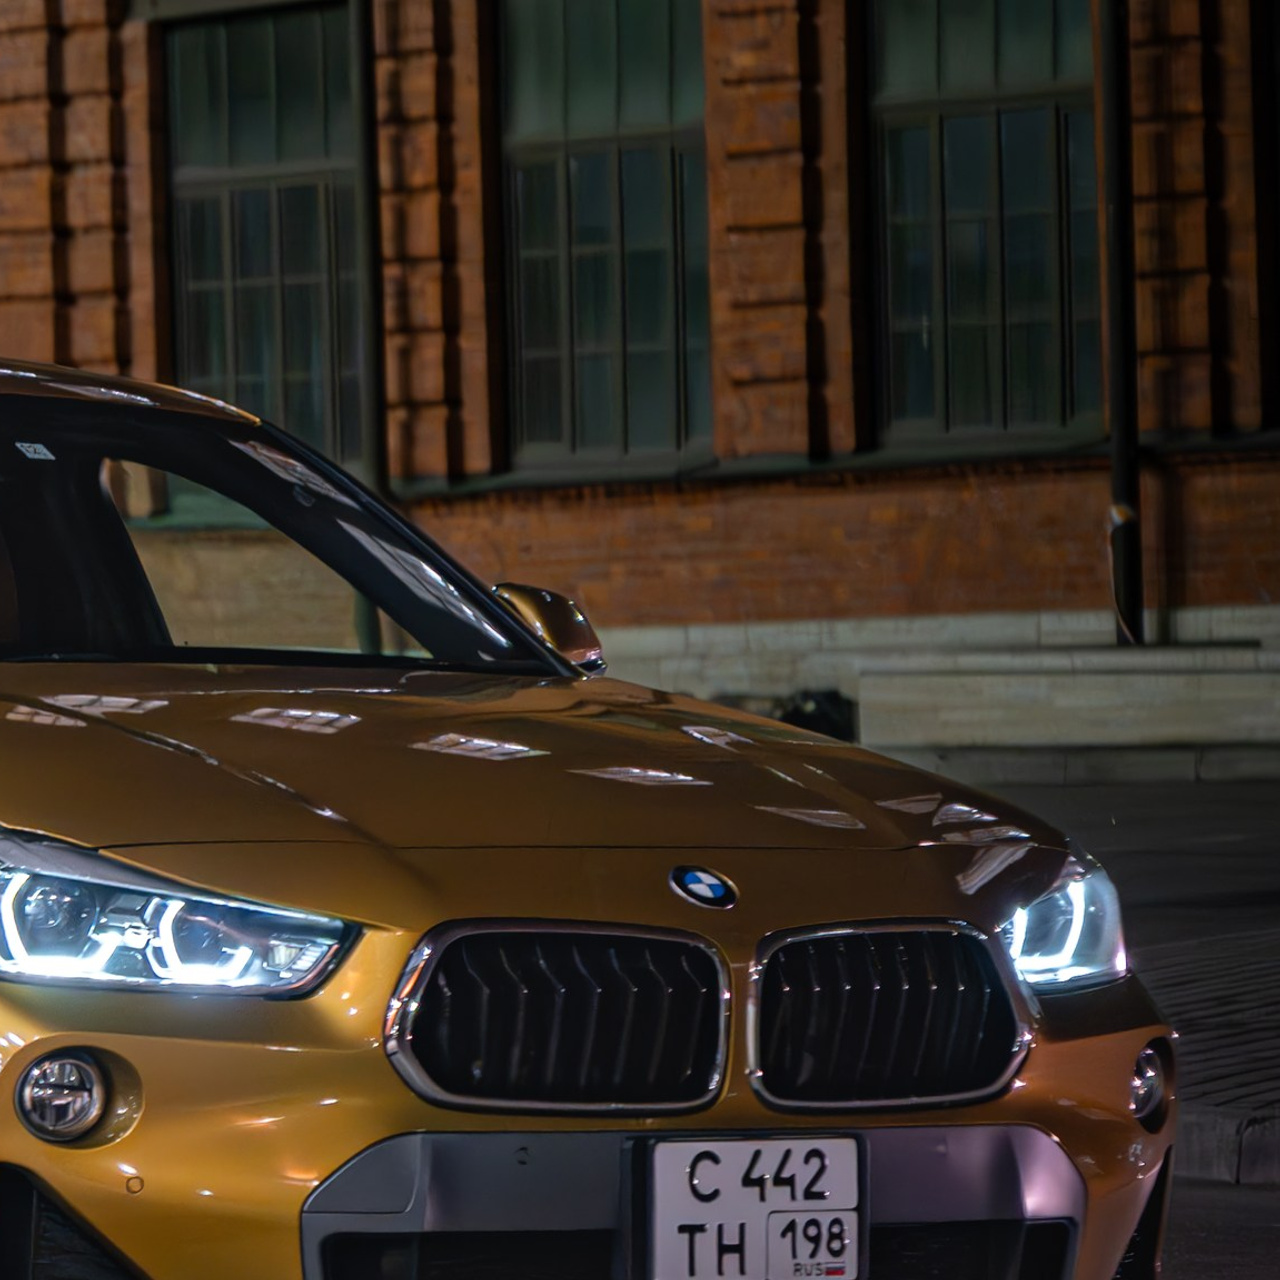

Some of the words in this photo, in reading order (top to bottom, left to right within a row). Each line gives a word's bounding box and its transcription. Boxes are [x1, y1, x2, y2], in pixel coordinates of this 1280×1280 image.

[688, 1149, 722, 1204] C
[741, 1147, 829, 1203] 442
[677, 1221, 747, 1277] TH
[779, 1216, 847, 1260] 198
[793, 1262, 824, 1277] RUS
